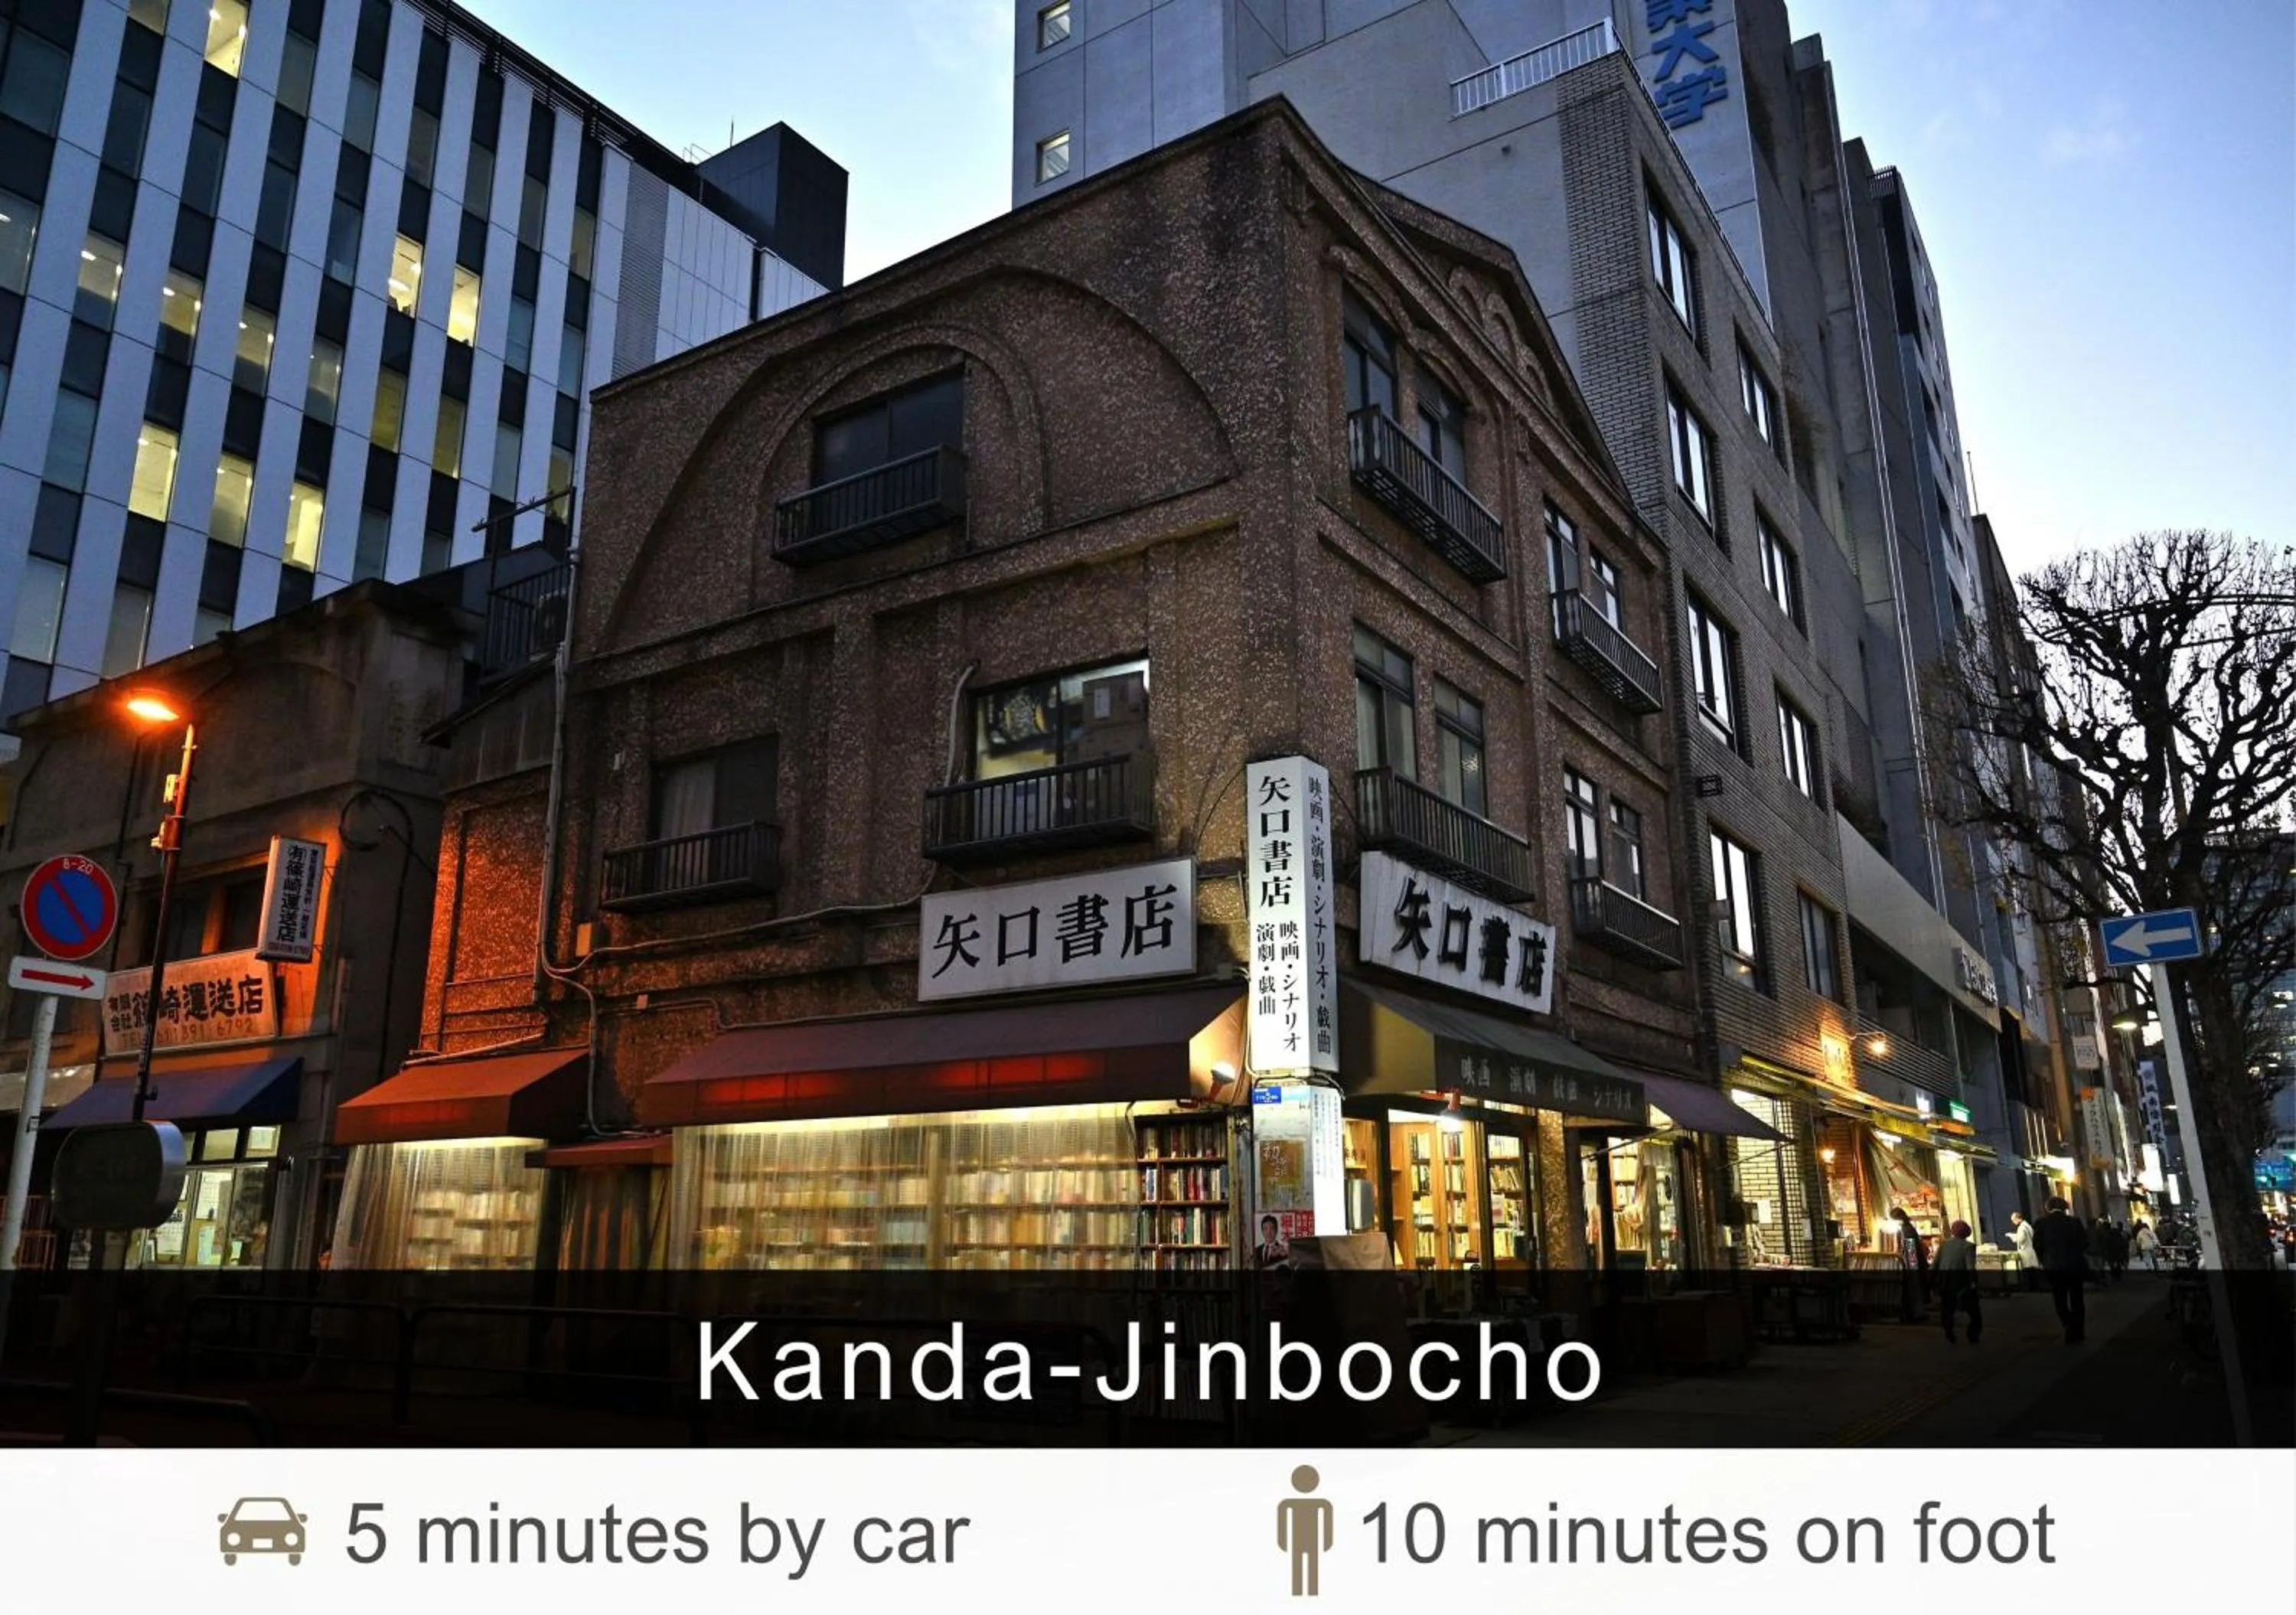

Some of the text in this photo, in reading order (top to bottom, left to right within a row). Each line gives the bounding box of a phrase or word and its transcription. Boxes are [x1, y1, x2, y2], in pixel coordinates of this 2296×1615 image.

[63, 858, 94, 875] 8-20
[1259, 775, 1293, 909] 矢口書店
[931, 883, 1177, 979] 矢口書店
[1391, 876, 1548, 997] 矢口書店
